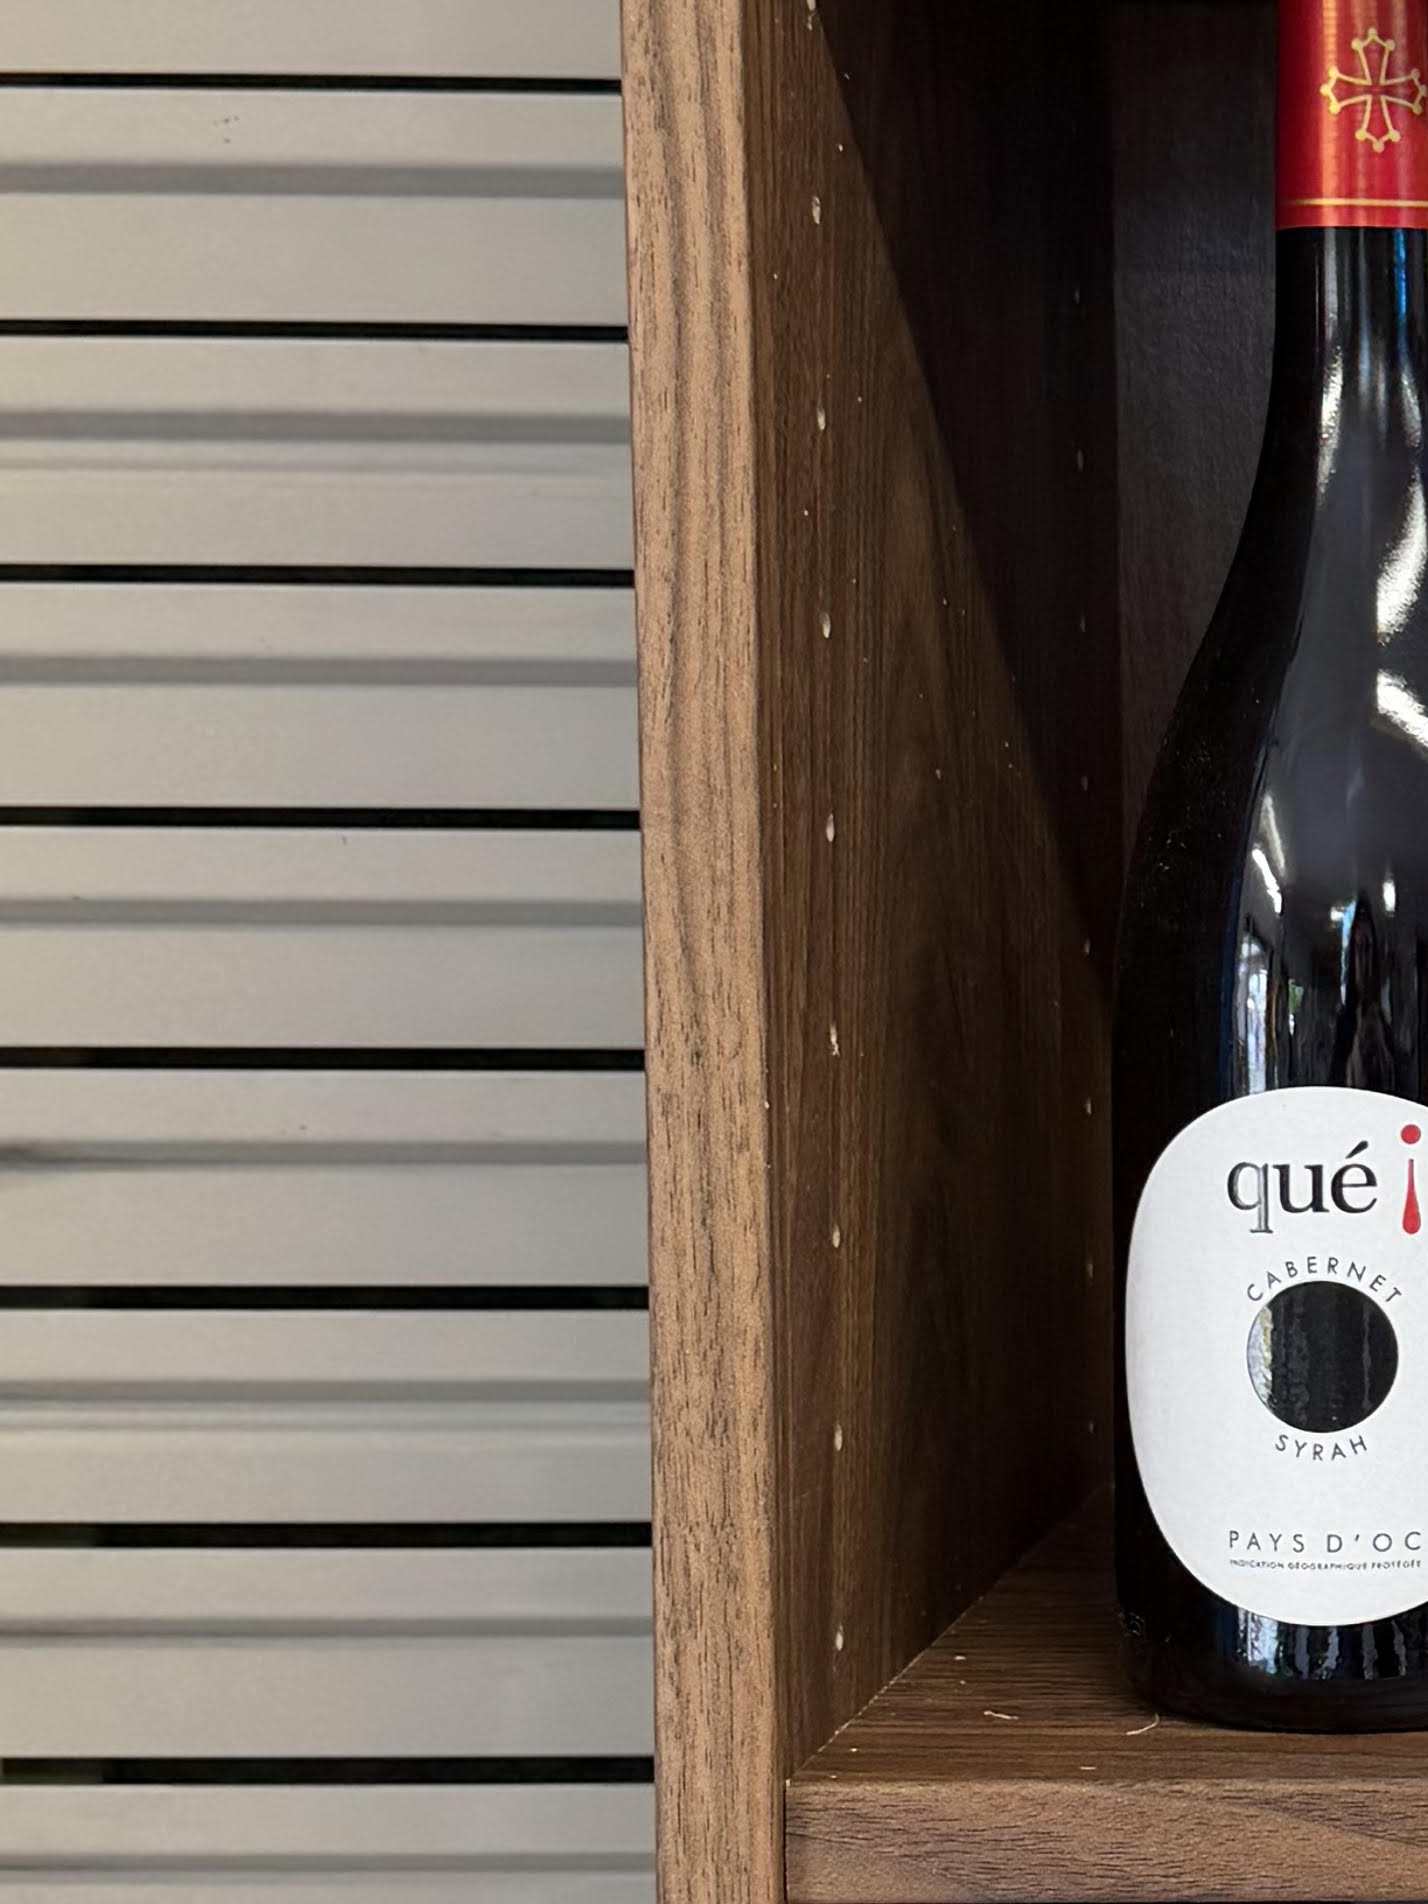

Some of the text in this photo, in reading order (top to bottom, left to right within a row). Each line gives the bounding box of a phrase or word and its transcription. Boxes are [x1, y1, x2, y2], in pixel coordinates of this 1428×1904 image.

[1247, 1256, 1402, 1304] CABERNET
[1275, 1434, 1367, 1460] SYRAH
[1229, 1530, 1421, 1553] PAYS D'OC
